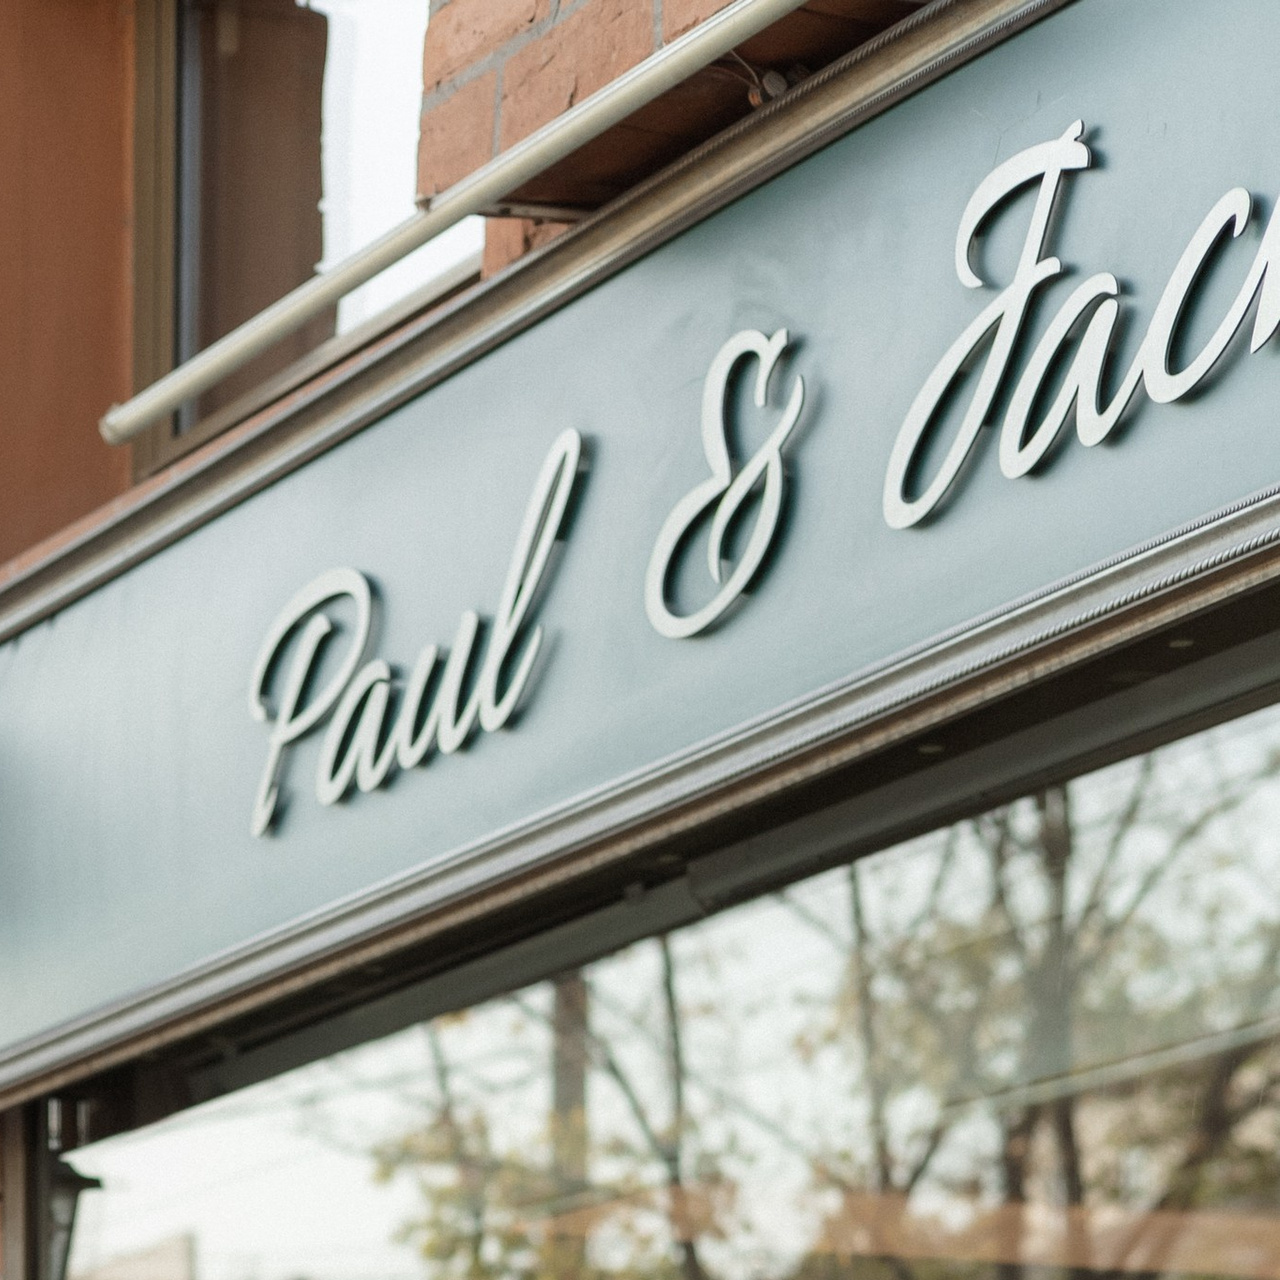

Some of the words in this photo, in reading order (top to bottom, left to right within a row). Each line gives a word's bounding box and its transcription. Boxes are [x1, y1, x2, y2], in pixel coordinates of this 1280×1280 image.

[249, 427, 581, 838] Paul
[645, 328, 805, 638] &
[883, 119, 1280, 530] Jac
